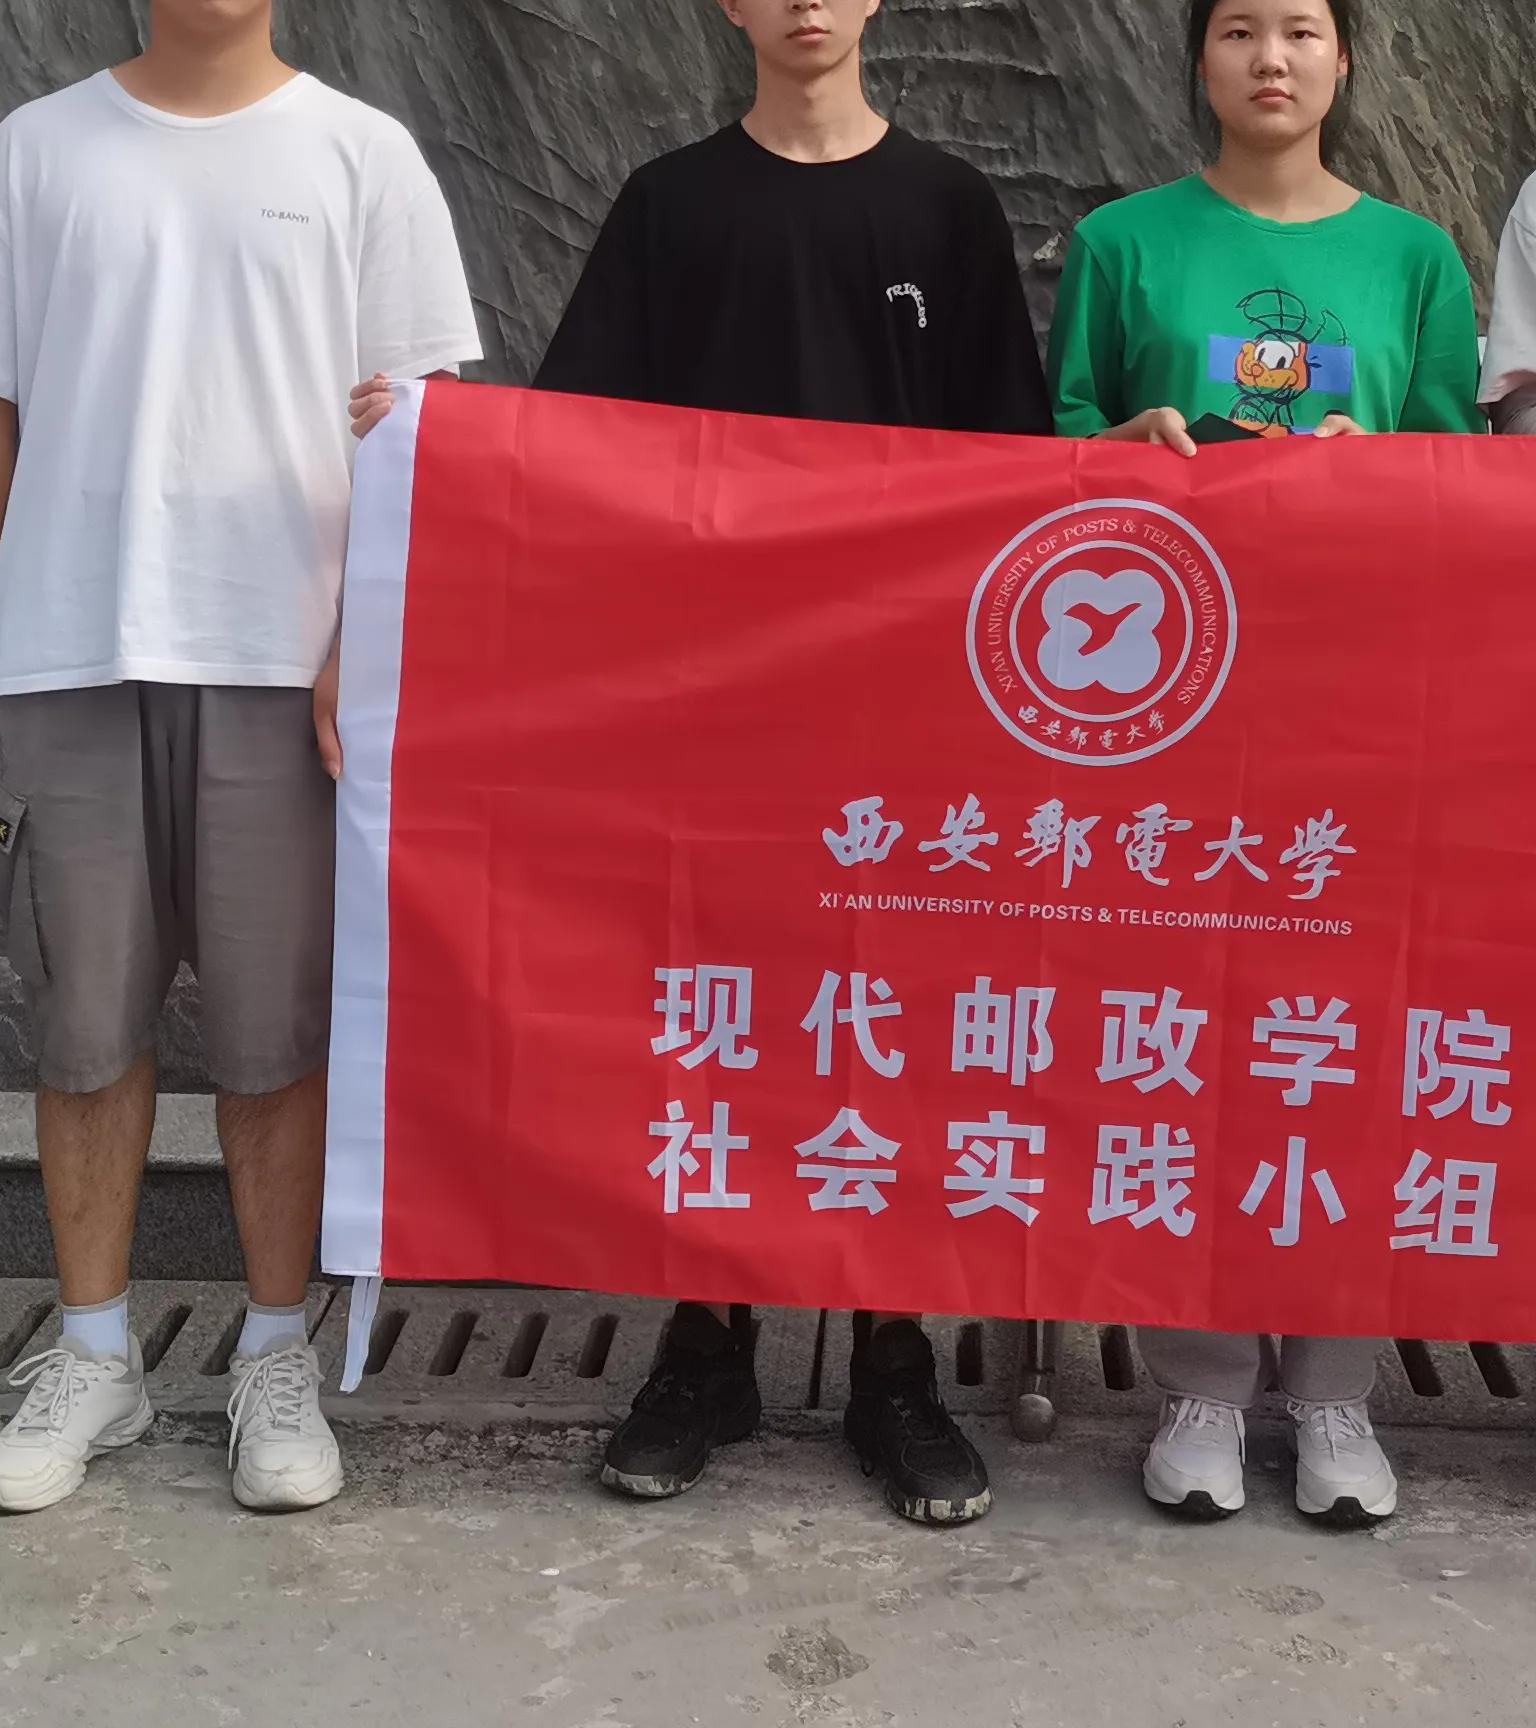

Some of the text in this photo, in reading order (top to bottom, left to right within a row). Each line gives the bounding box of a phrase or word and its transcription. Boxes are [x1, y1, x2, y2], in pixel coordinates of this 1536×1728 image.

[987, 551, 1034, 646] UNIVERSITY
[1036, 534, 1059, 555] OF
[1062, 518, 1119, 543] POSTS
[1122, 519, 1137, 534] &
[1143, 523, 1217, 705] TELECOMMUNICATIONS
[877, 895, 994, 915] UNIVERSITY
[999, 902, 1025, 917] OF
[1029, 904, 1093, 922] POSTS
[1097, 907, 1112, 923] &
[1117, 908, 1353, 936] TELECOMMUNICATIONS
[651, 963, 1515, 1128] 现代邮政学院
[646, 1100, 1501, 1259] 社会实践小组
